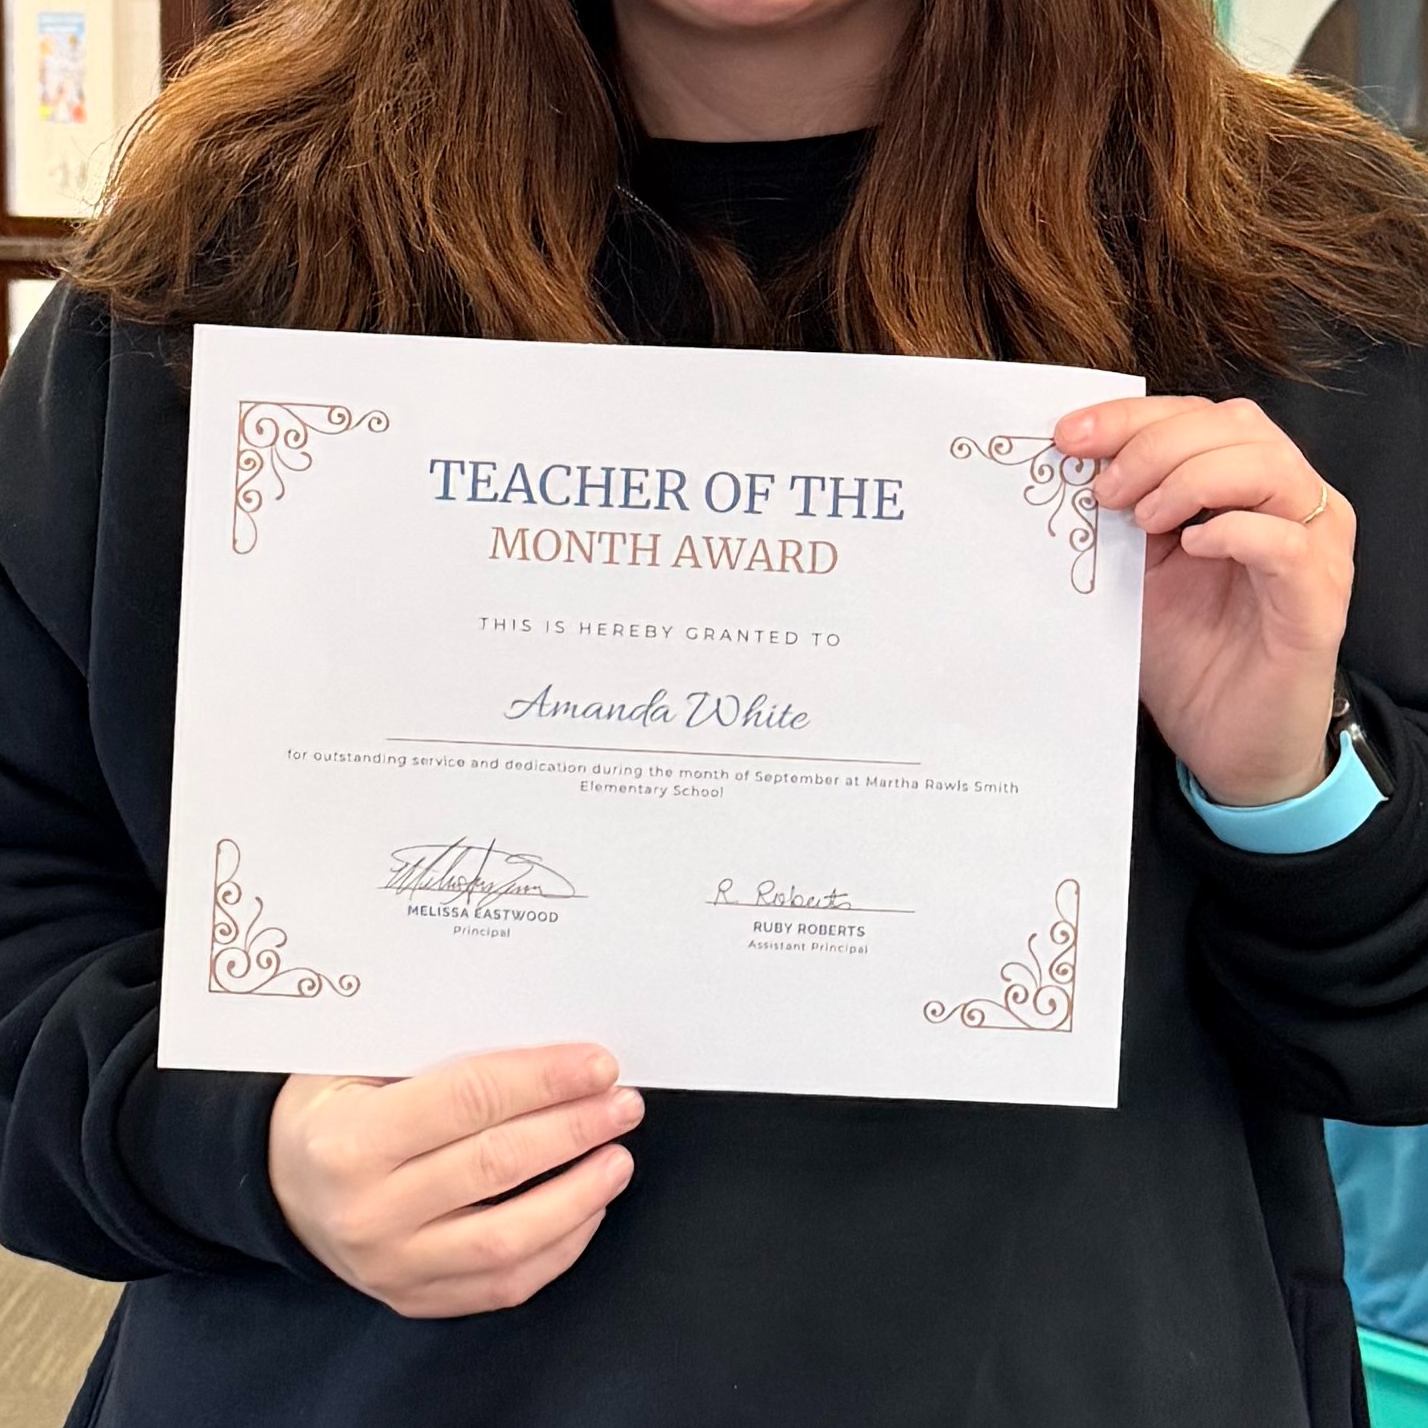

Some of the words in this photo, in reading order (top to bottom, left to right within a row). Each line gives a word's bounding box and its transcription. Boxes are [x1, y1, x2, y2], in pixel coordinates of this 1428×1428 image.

[429, 459, 690, 510] TEACHER
[704, 471, 774, 514] OF
[790, 475, 905, 520] THE
[488, 526, 661, 567] MONTH
[672, 534, 839, 574] AWARD
[479, 617, 532, 633] THIS
[546, 620, 565, 634] IS
[579, 622, 673, 639] HEREBY
[686, 627, 799, 645] GRANTED
[812, 633, 841, 647] TO
[504, 684, 676, 728] Amanda
[685, 691, 810, 730] White
[287, 749, 307, 761] for
[313, 750, 407, 768] outstanding
[412, 756, 466, 768] service
[472, 758, 499, 770] and
[505, 759, 586, 774] dedication
[592, 763, 643, 779] during
[648, 766, 673, 778] the
[679, 768, 729, 781] month
[734, 769, 749, 781] of
[755, 771, 840, 788] September
[845, 776, 861, 788] at
[865, 776, 920, 790] Martha
[925, 779, 969, 793] Rawls
[974, 781, 1020, 795] Smith
[580, 780, 668, 799] Elementary
[673, 784, 724, 799] School
[407, 904, 470, 919] MELISSA
[474, 907, 559, 923] EASTWOOD
[453, 924, 511, 939] Principal
[753, 921, 793, 934] RUBY
[797, 923, 866, 937] ROBERTS
[747, 939, 806, 951] Assistant
[811, 942, 869, 955] Principal
